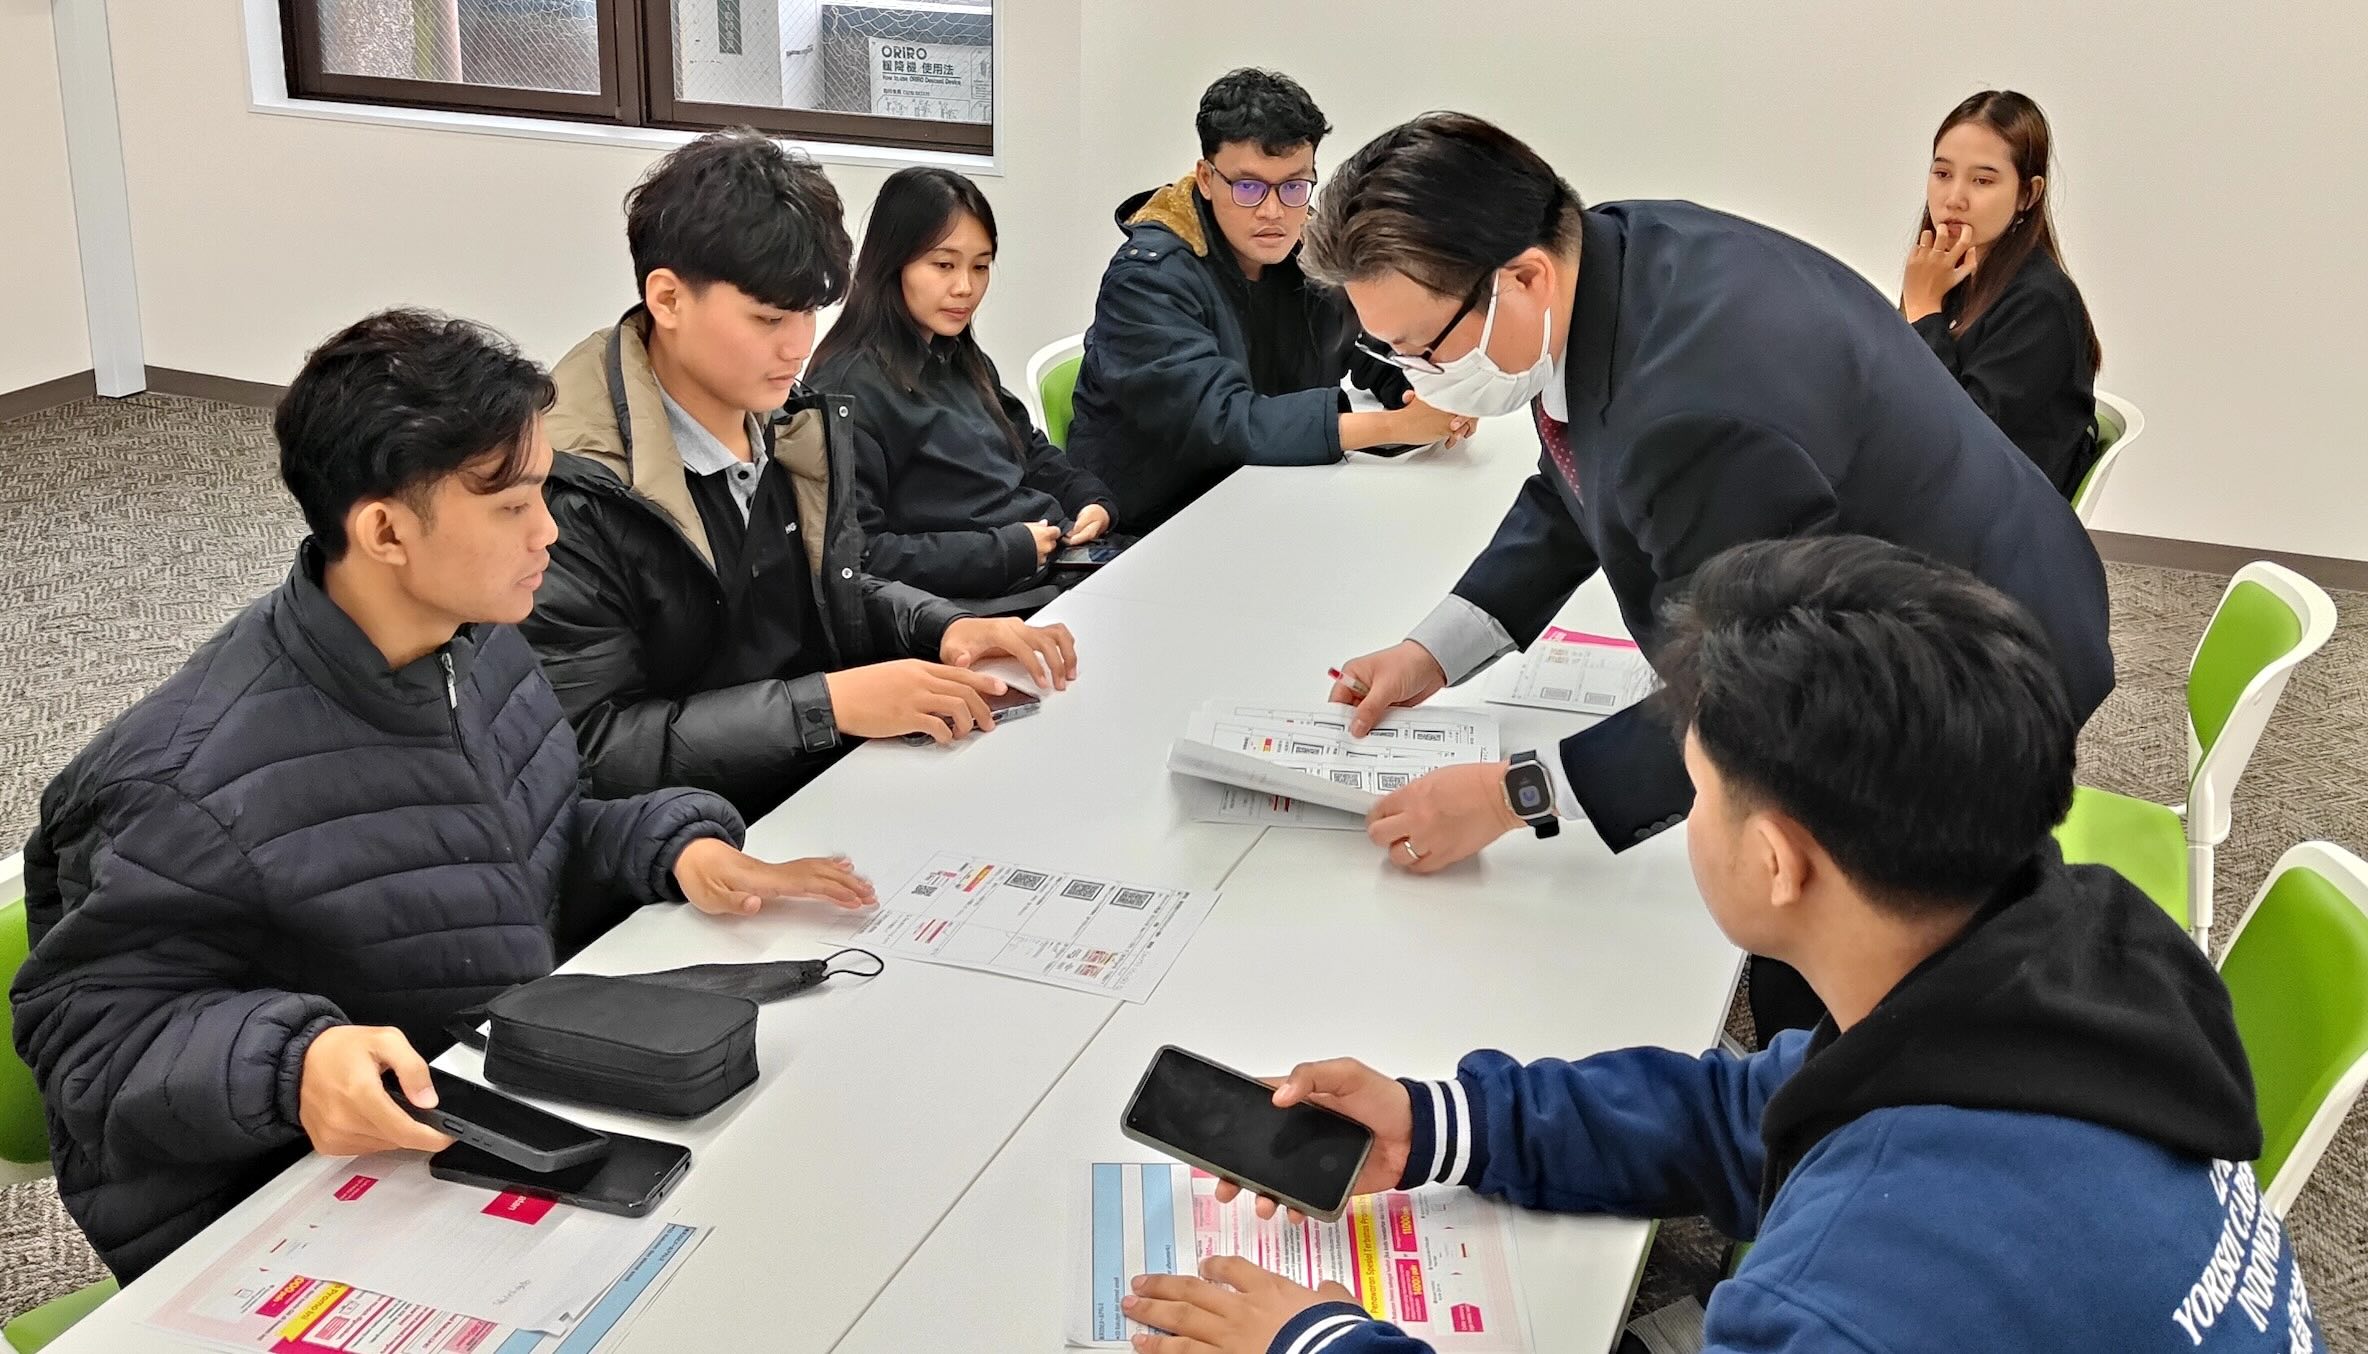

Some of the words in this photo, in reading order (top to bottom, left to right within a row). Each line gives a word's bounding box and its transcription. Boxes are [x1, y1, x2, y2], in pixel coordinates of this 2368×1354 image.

[881, 45, 928, 60] ORIRO
[921, 62, 956, 76] 使用法
[1362, 1225, 1373, 1252] Terbatas
[1365, 1253, 1375, 1276] Spesial
[2172, 1218, 2246, 1346] YORISOI
[312, 1288, 339, 1311] Promo
[1369, 1275, 1378, 1314] Penawaran
